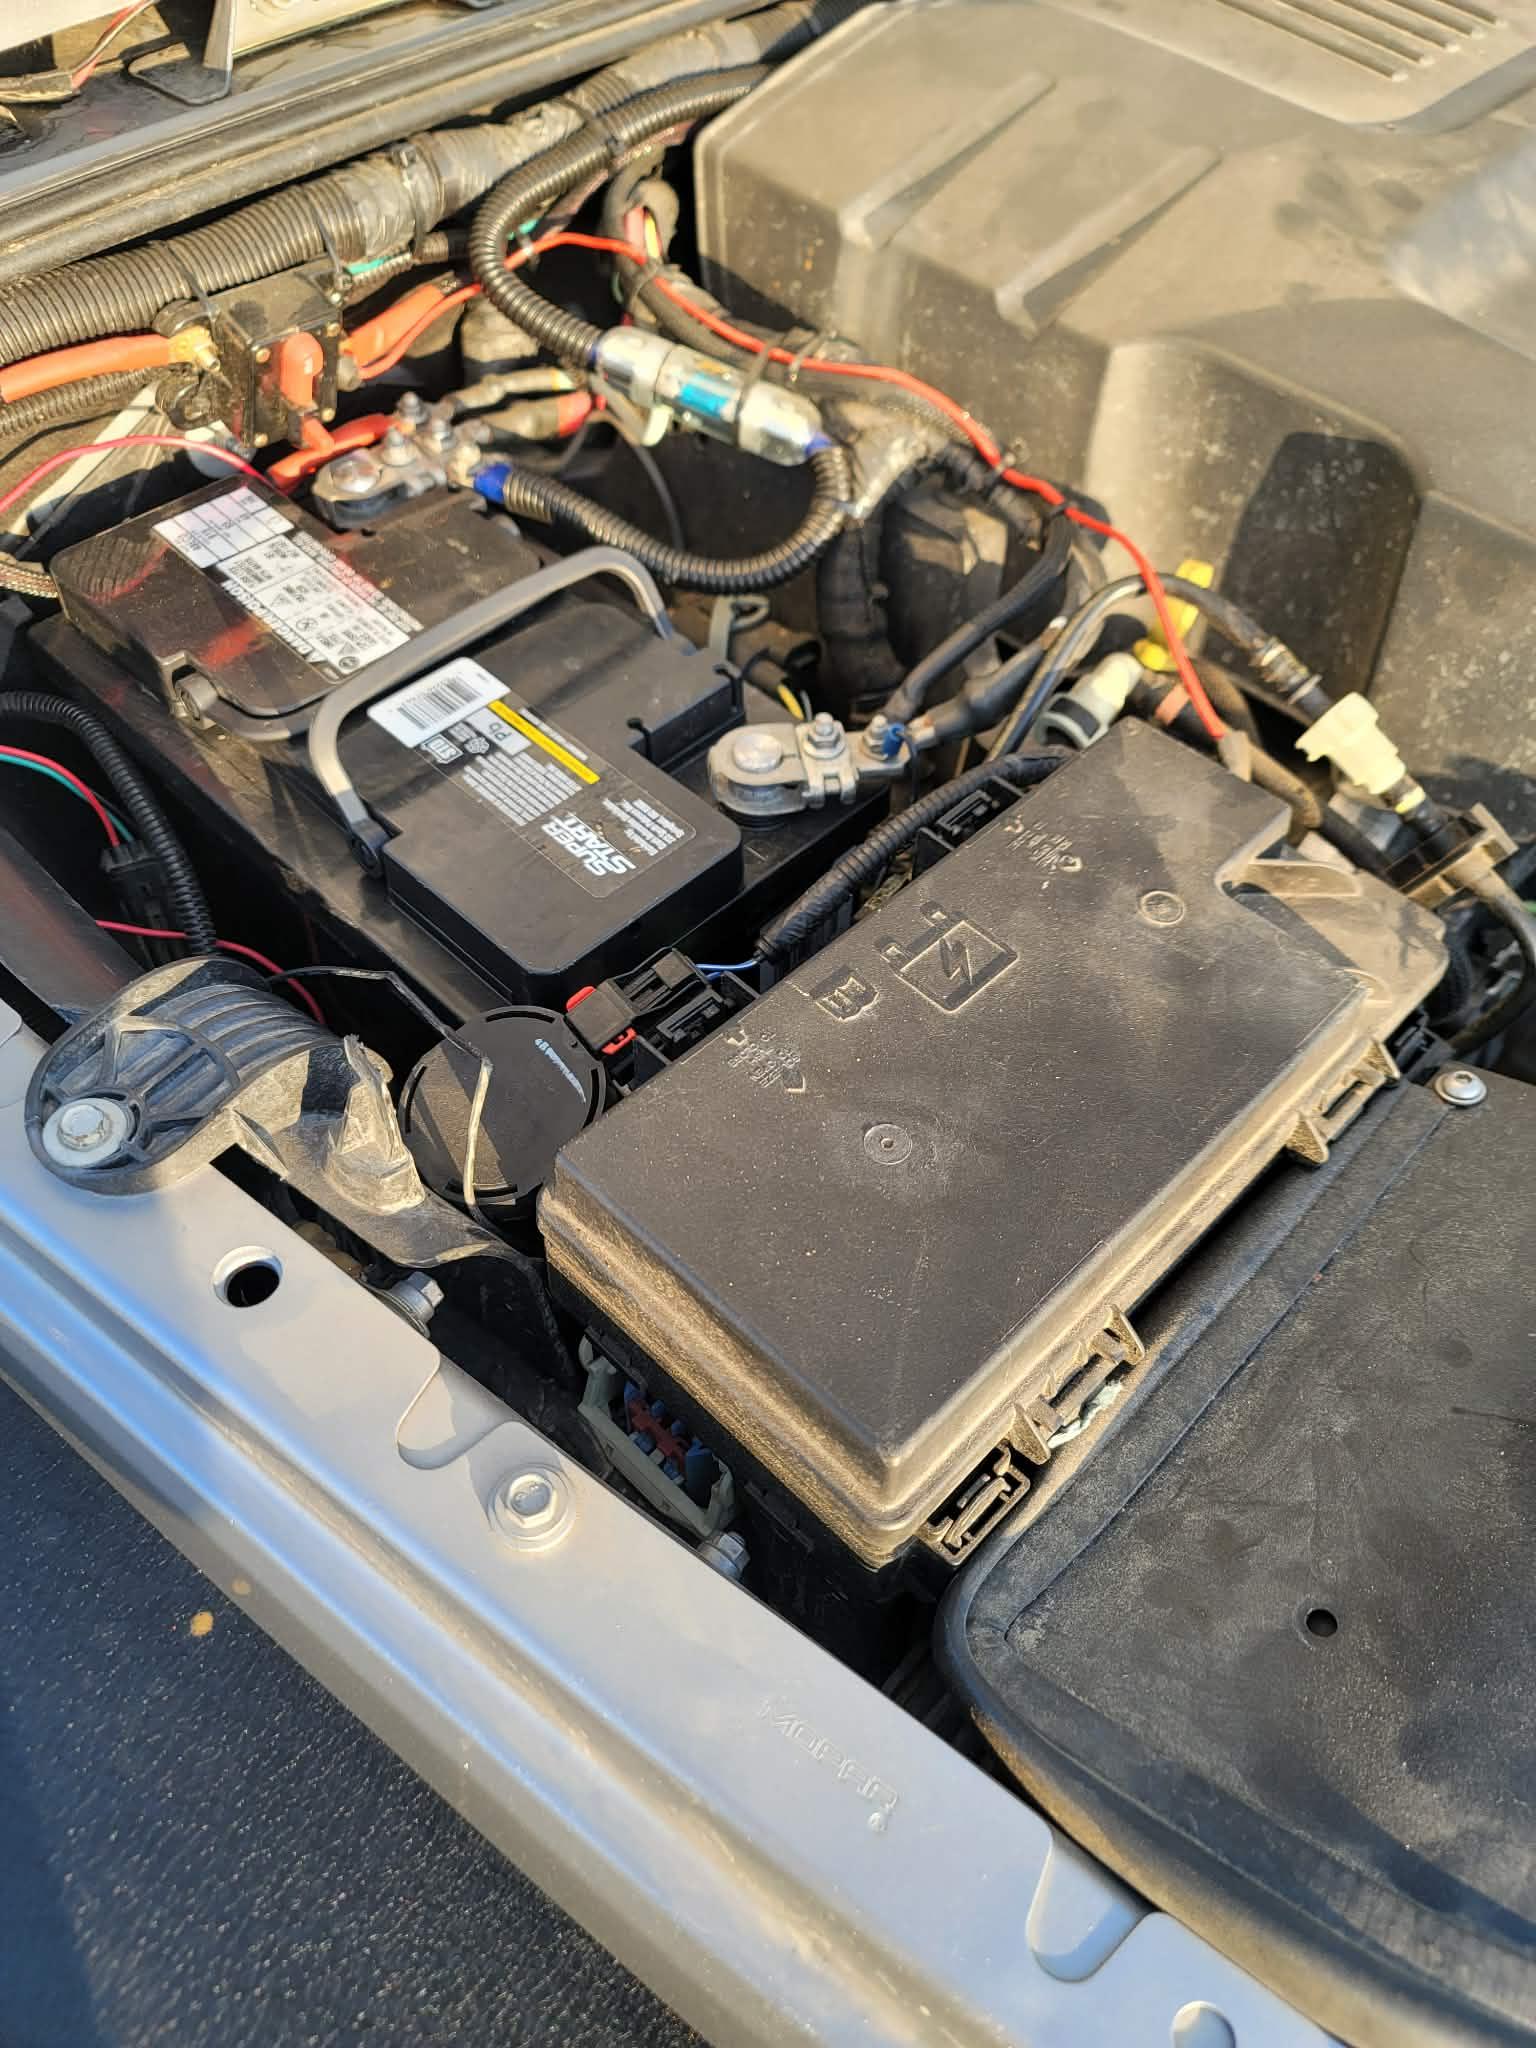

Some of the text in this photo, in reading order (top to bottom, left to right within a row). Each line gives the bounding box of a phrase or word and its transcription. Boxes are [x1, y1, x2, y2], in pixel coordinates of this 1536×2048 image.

[488, 721, 511, 741] Pb
[541, 822, 609, 875] SUPER
[550, 815, 636, 874] START
